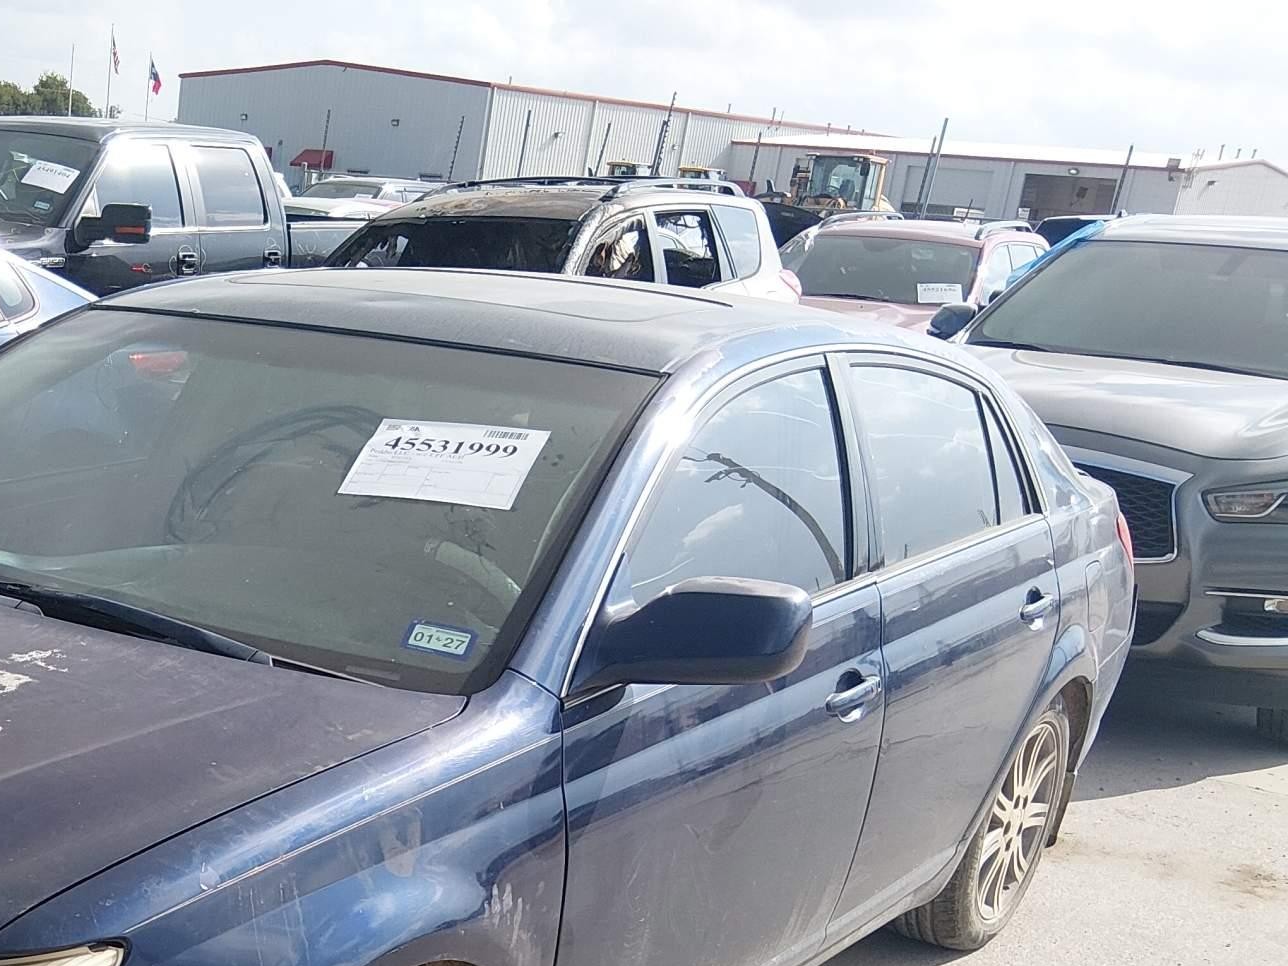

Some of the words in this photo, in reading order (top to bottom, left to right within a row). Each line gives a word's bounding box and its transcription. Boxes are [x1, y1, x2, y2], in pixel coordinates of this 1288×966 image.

[384, 436, 518, 459] 45531999
[414, 631, 433, 644] 01
[442, 637, 466, 650] 27
